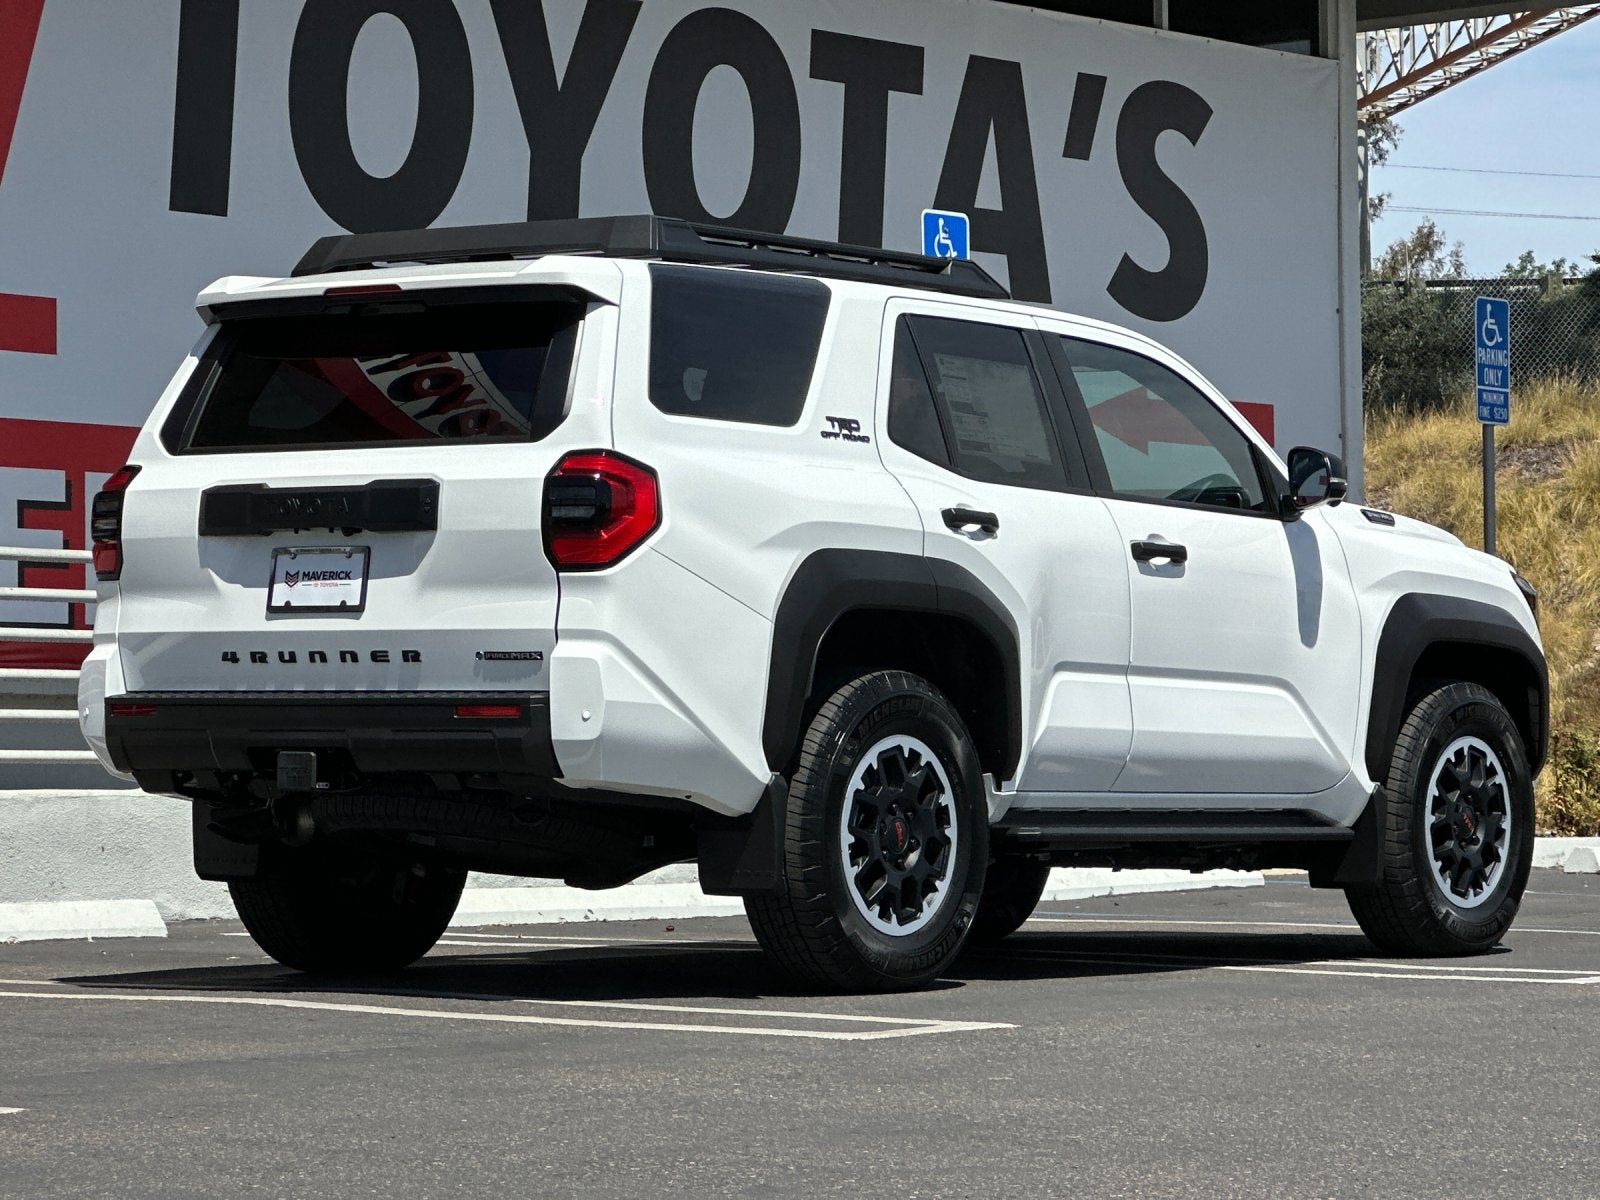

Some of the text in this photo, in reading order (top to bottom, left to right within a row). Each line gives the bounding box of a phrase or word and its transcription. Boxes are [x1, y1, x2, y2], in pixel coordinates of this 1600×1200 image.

[1478, 347, 1508, 366] PARKING
[1484, 367, 1502, 386] ONLY
[302, 570, 352, 581] MAVERICK
[221, 650, 422, 664] 4RUNNER
